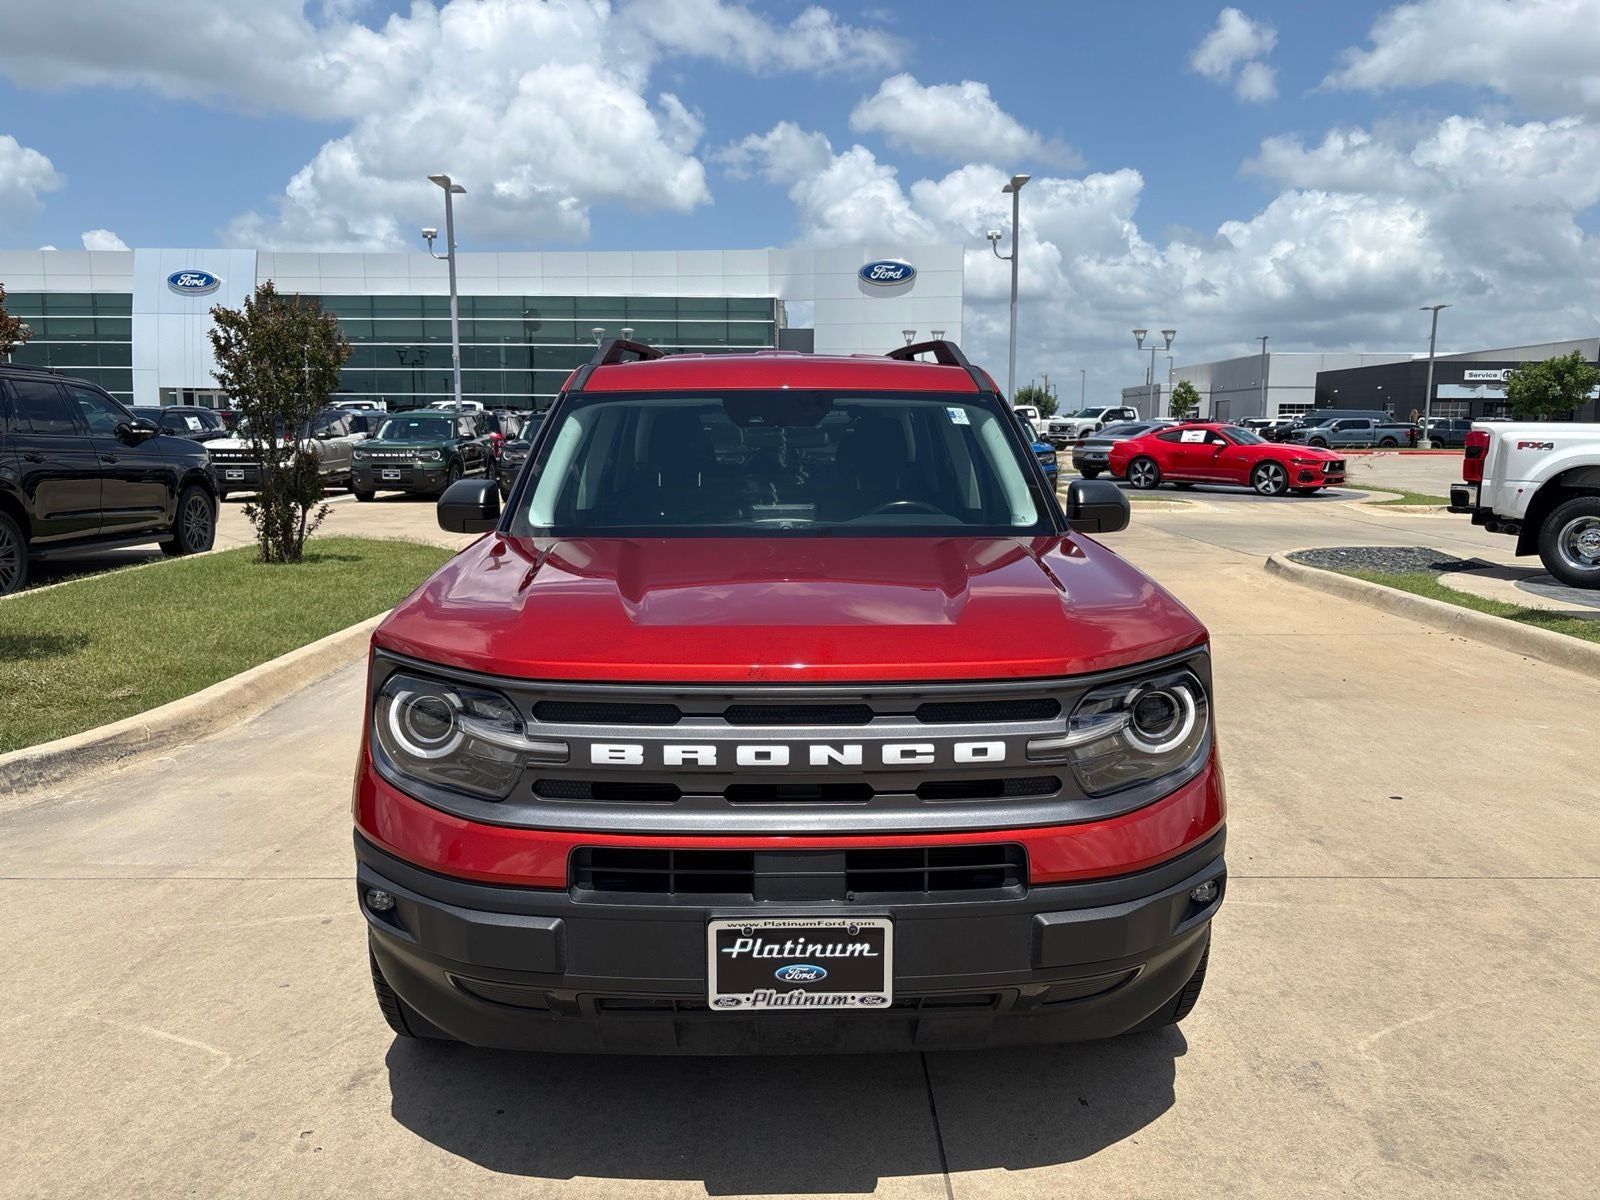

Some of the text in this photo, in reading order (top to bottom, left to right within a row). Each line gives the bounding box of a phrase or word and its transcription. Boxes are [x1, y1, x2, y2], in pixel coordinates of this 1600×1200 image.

[871, 264, 904, 279] Ford
[177, 273, 207, 286] Ford
[1468, 371, 1498, 379] Service
[1517, 441, 1554, 451] FX4
[590, 741, 1006, 766] BRONCO
[727, 920, 875, 928] www.PlatinumFord.com
[721, 937, 879, 959] Platinum
[785, 967, 817, 981] Ford
[718, 990, 883, 1007] Ford Platinum Ford
